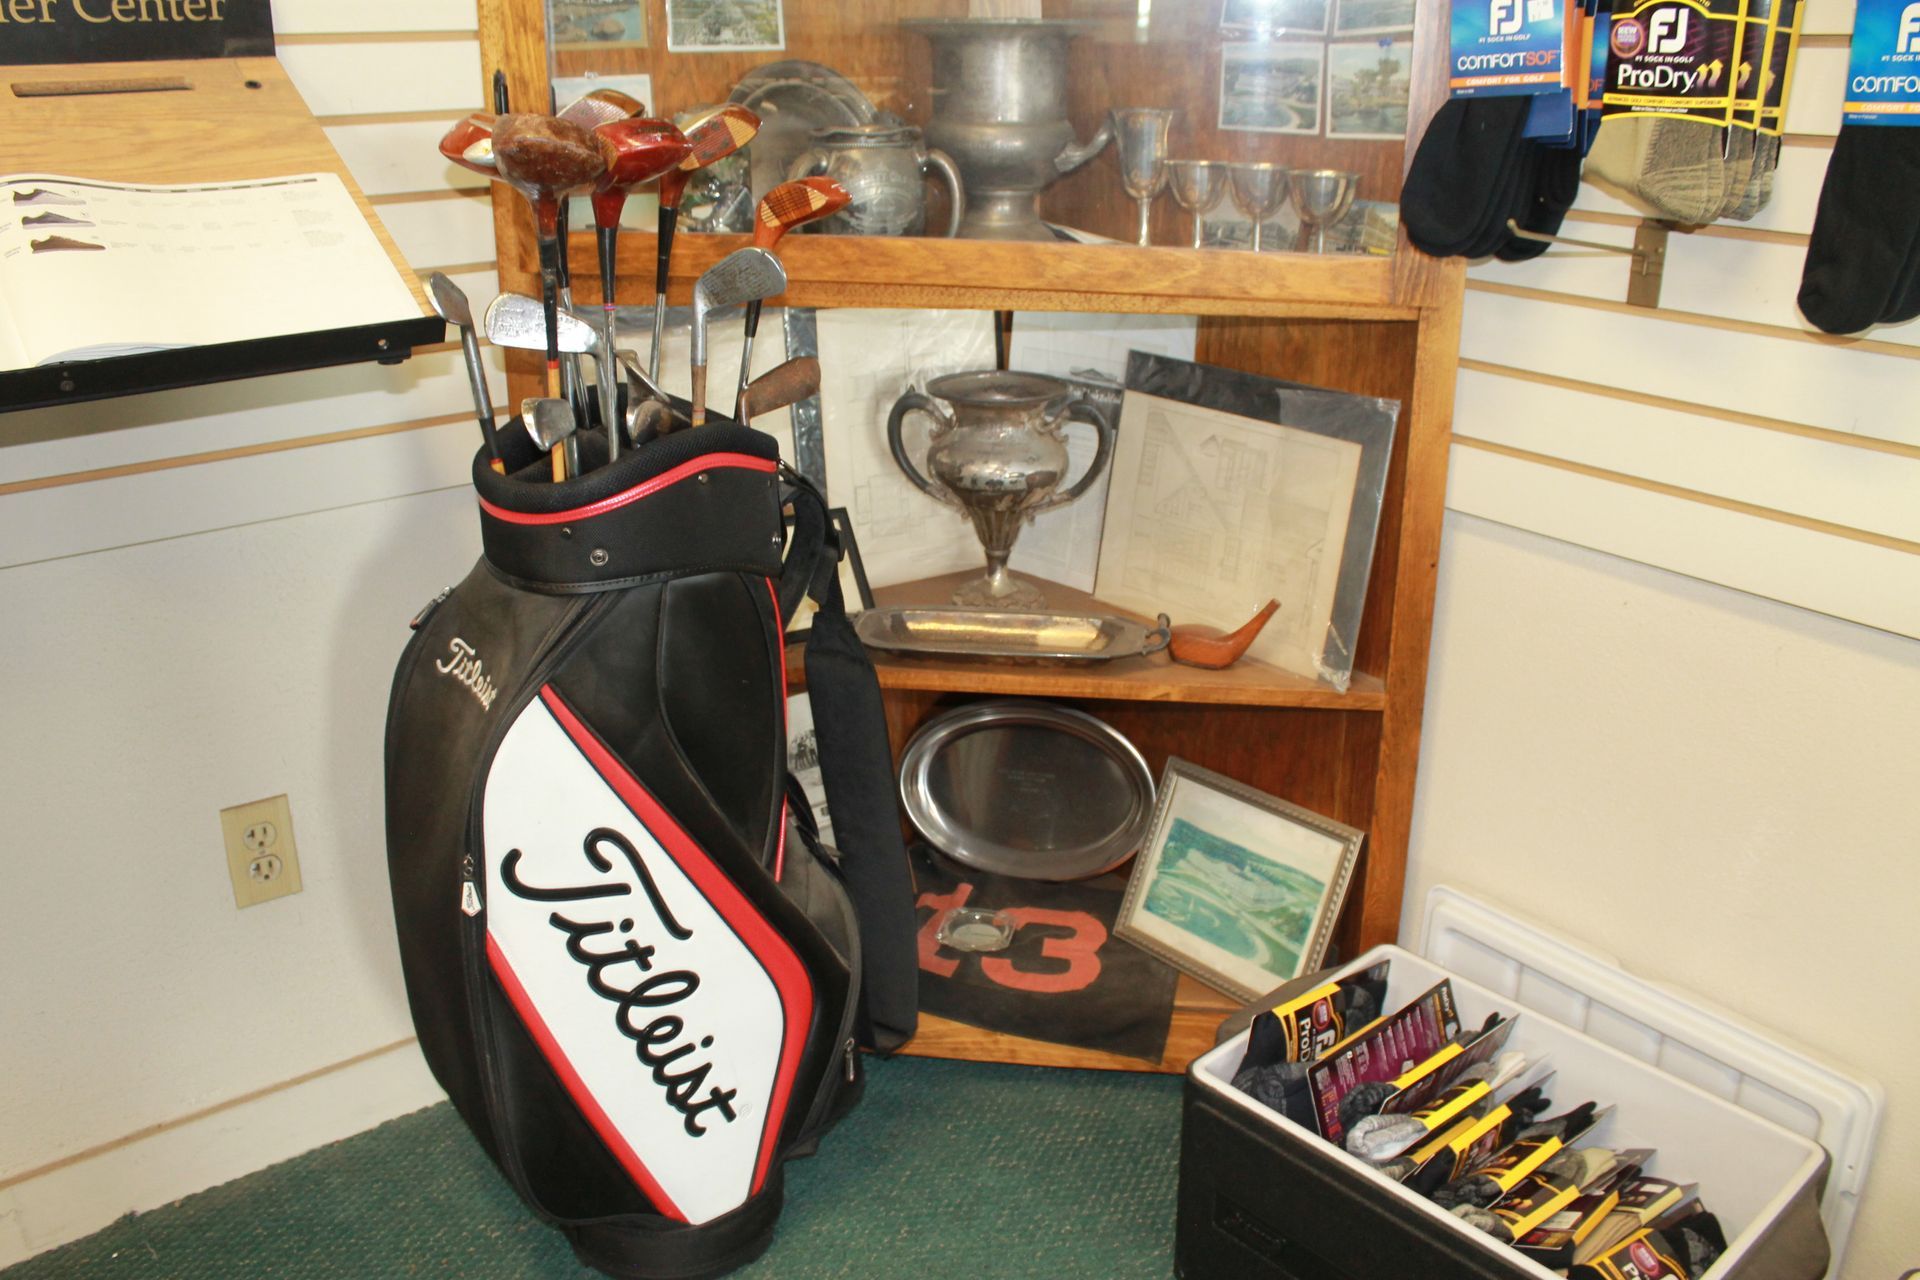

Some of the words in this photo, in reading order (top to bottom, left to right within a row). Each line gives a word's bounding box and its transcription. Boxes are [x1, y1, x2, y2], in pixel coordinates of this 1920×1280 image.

[72, 0, 225, 23] Center
[1648, 8, 1689, 53] FJ
[1644, 55, 1663, 63] SOCK
[1617, 63, 1699, 94] ProDry
[436, 637, 498, 711] Titleist
[500, 827, 737, 1157] Titleist
